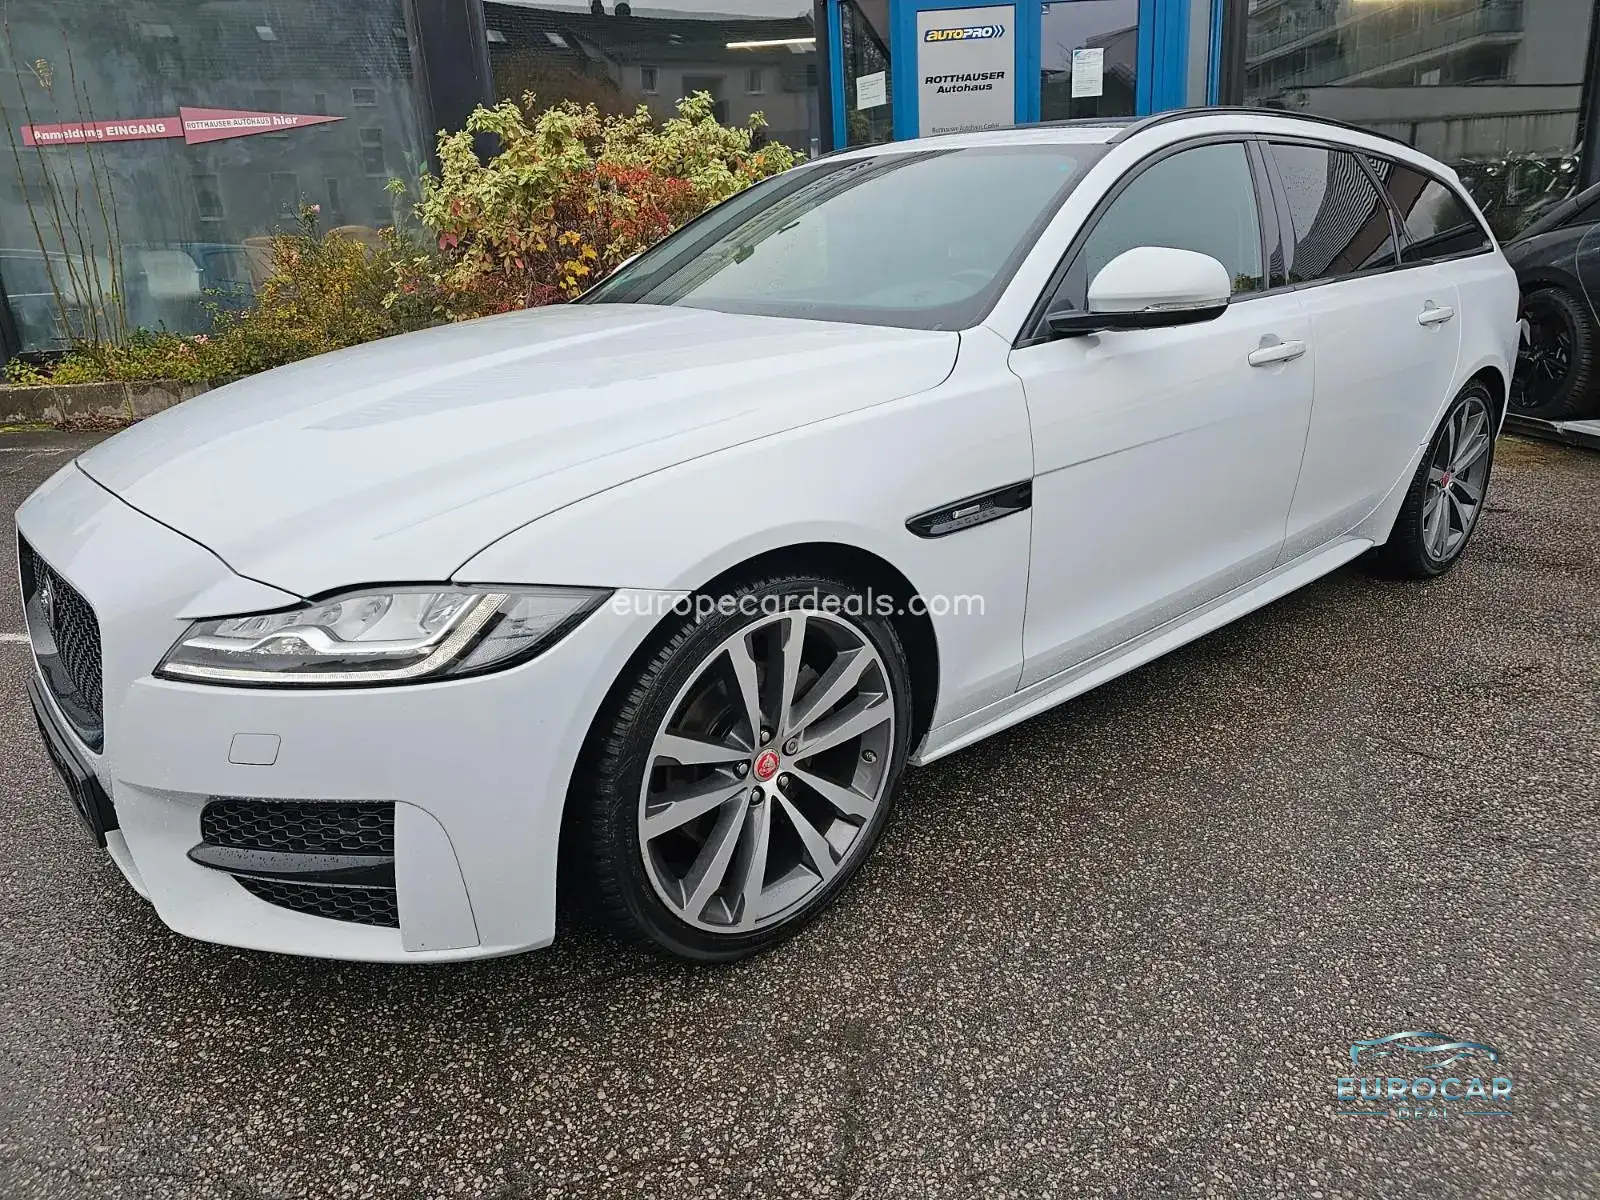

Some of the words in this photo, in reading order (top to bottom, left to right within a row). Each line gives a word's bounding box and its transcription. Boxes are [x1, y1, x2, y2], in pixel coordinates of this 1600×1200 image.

[925, 71, 1005, 84] ROTTHAUSER
[937, 83, 993, 93] Autohaus
[186, 119, 232, 129] ROTTHAUSER
[233, 117, 270, 126] AUTOHAUS
[272, 115, 298, 125] hier
[105, 123, 166, 136] EINGANG
